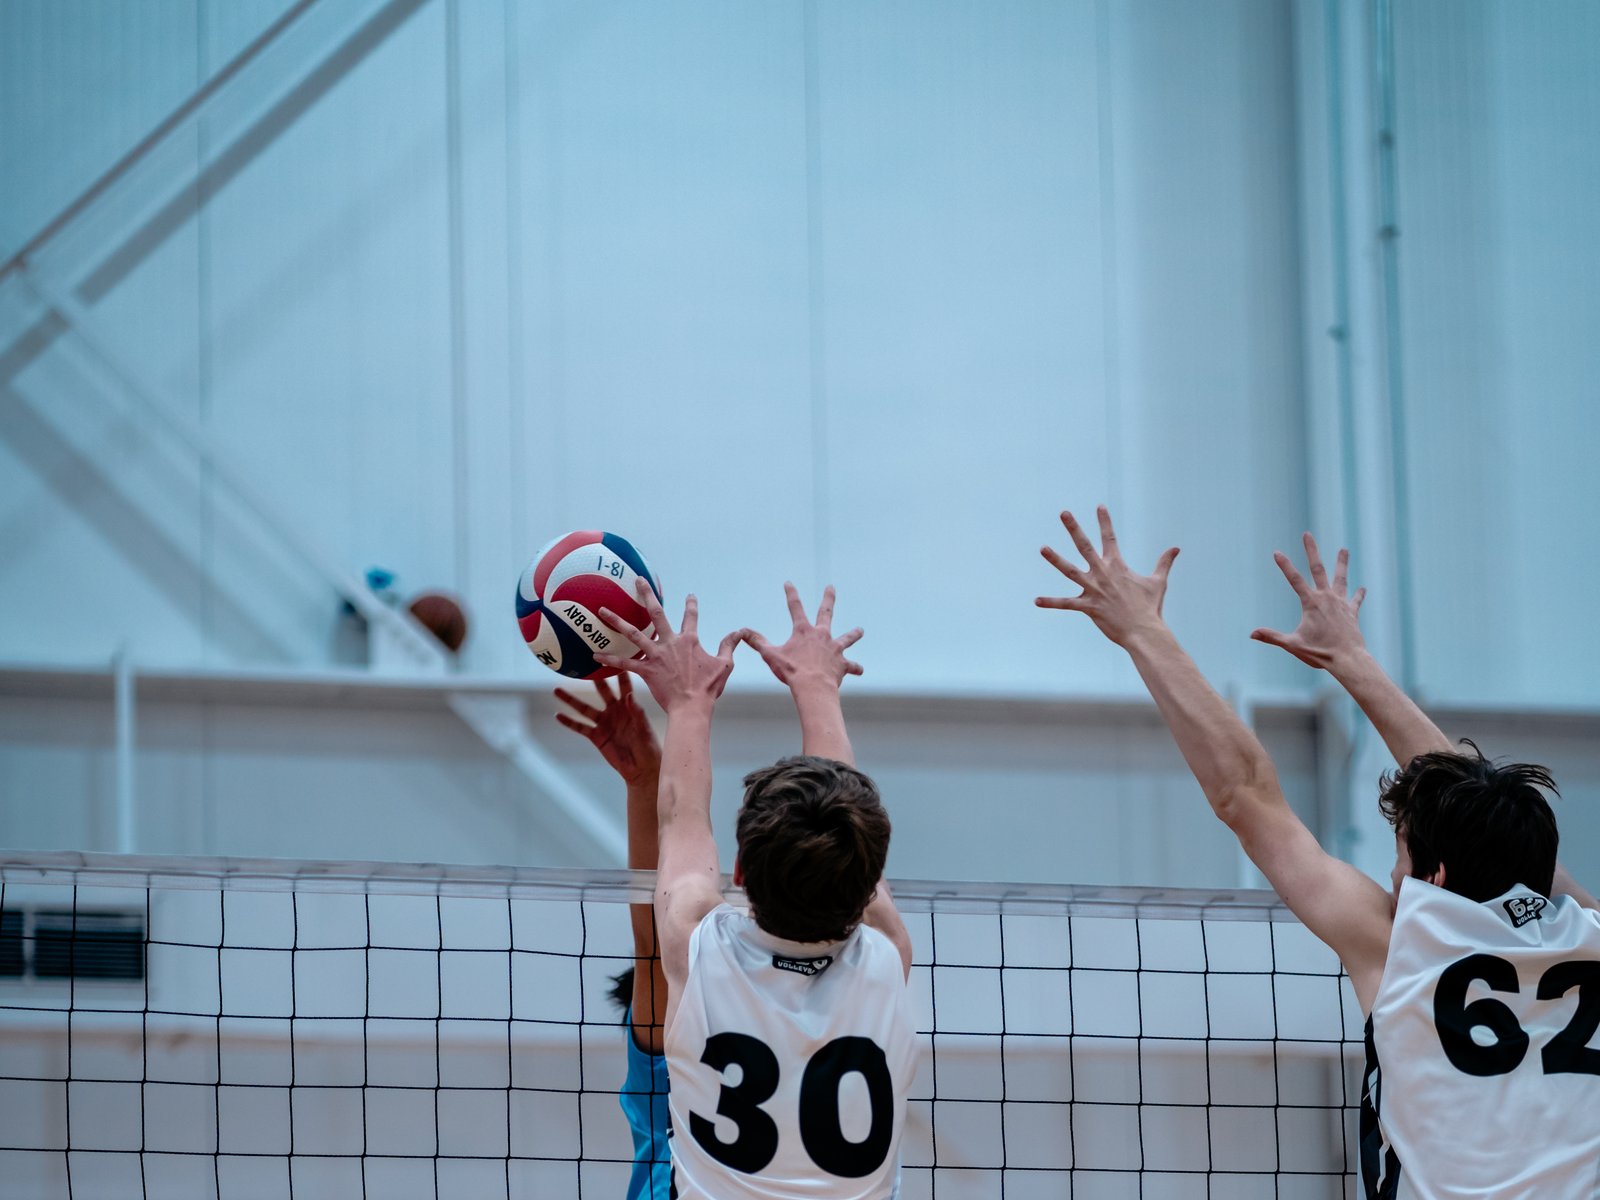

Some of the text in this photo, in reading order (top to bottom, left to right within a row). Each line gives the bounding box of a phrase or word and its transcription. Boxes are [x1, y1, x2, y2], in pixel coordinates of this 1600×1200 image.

[563, 604, 611, 650] BAY BAY
[777, 961, 816, 975] VOLLEYB
[1433, 953, 1600, 1077] 62
[689, 1031, 895, 1179] 30
